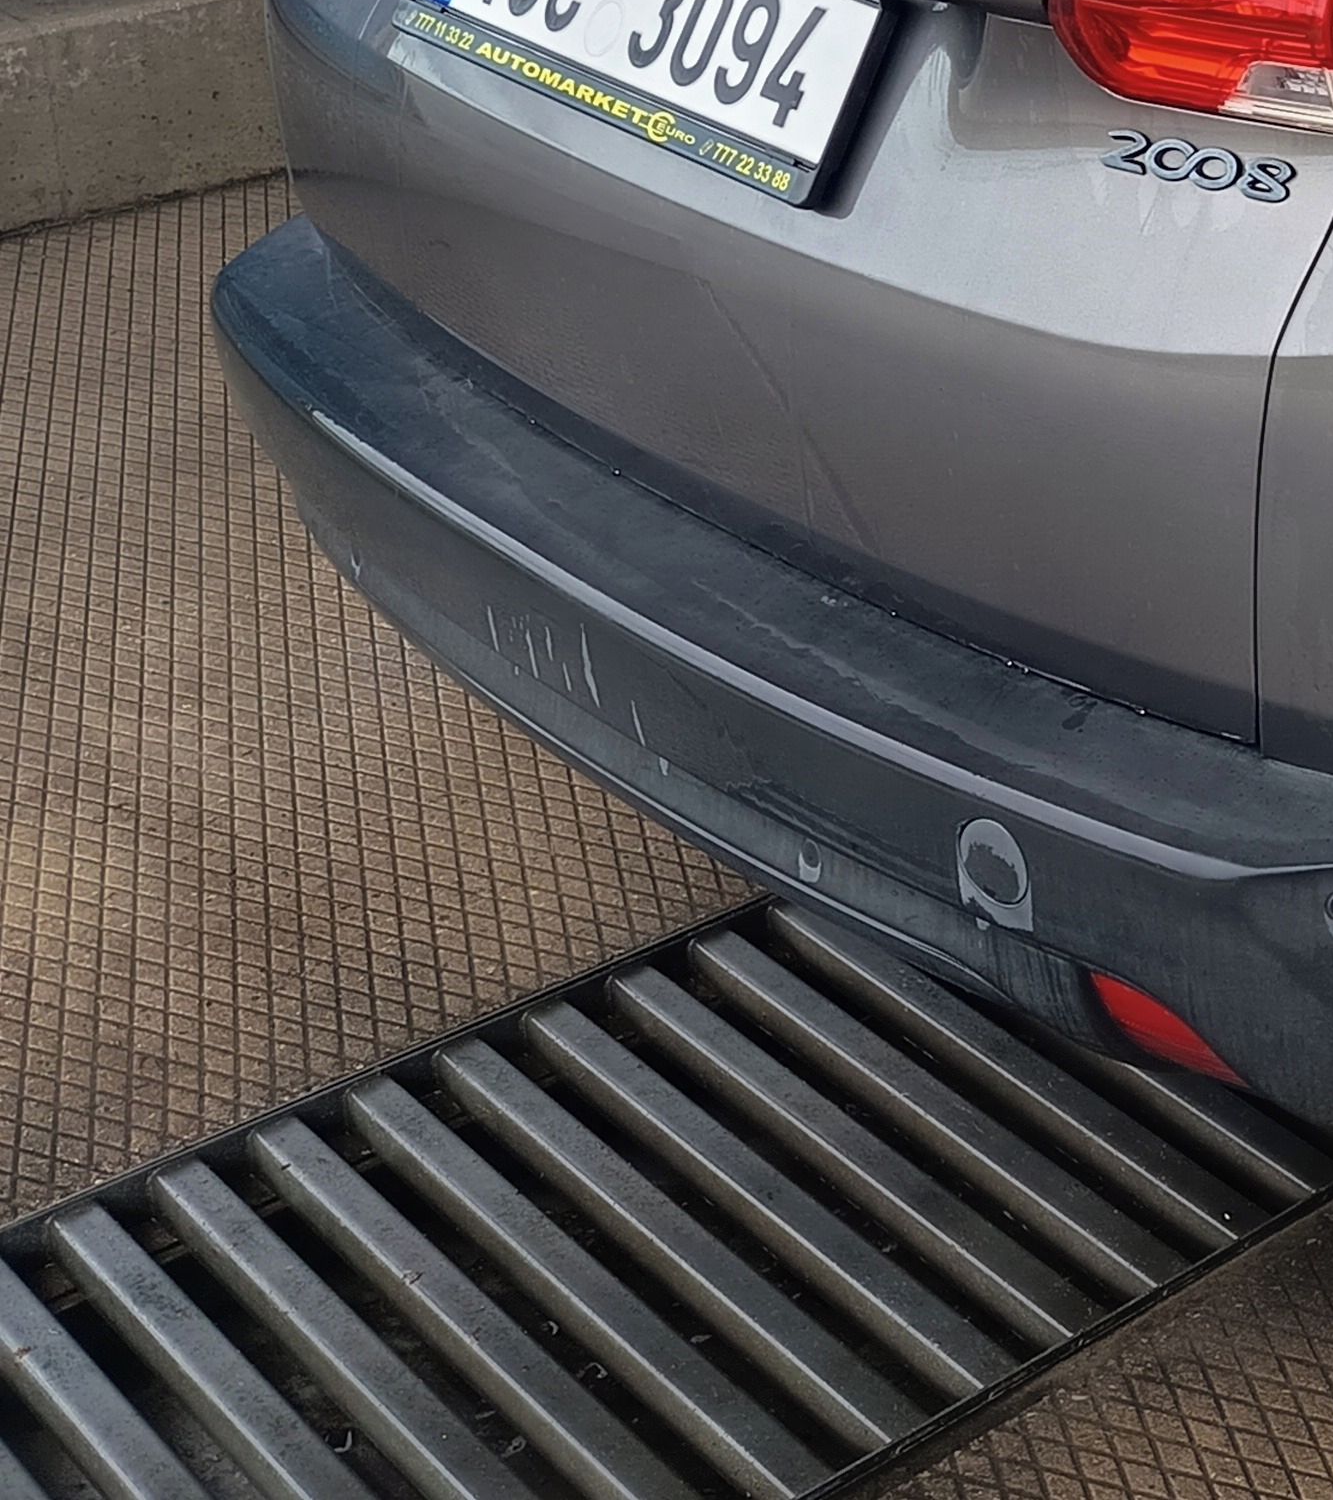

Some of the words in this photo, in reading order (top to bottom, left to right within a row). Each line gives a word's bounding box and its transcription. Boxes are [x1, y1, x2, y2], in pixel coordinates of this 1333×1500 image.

[415, 12, 435, 33] 777
[476, 41, 648, 126] AUTOMARKET
[712, 142, 738, 167] 777
[736, 153, 753, 176] 22
[753, 161, 772, 183] 33
[771, 169, 791, 191] 88
[1101, 129, 1297, 204] 2008
